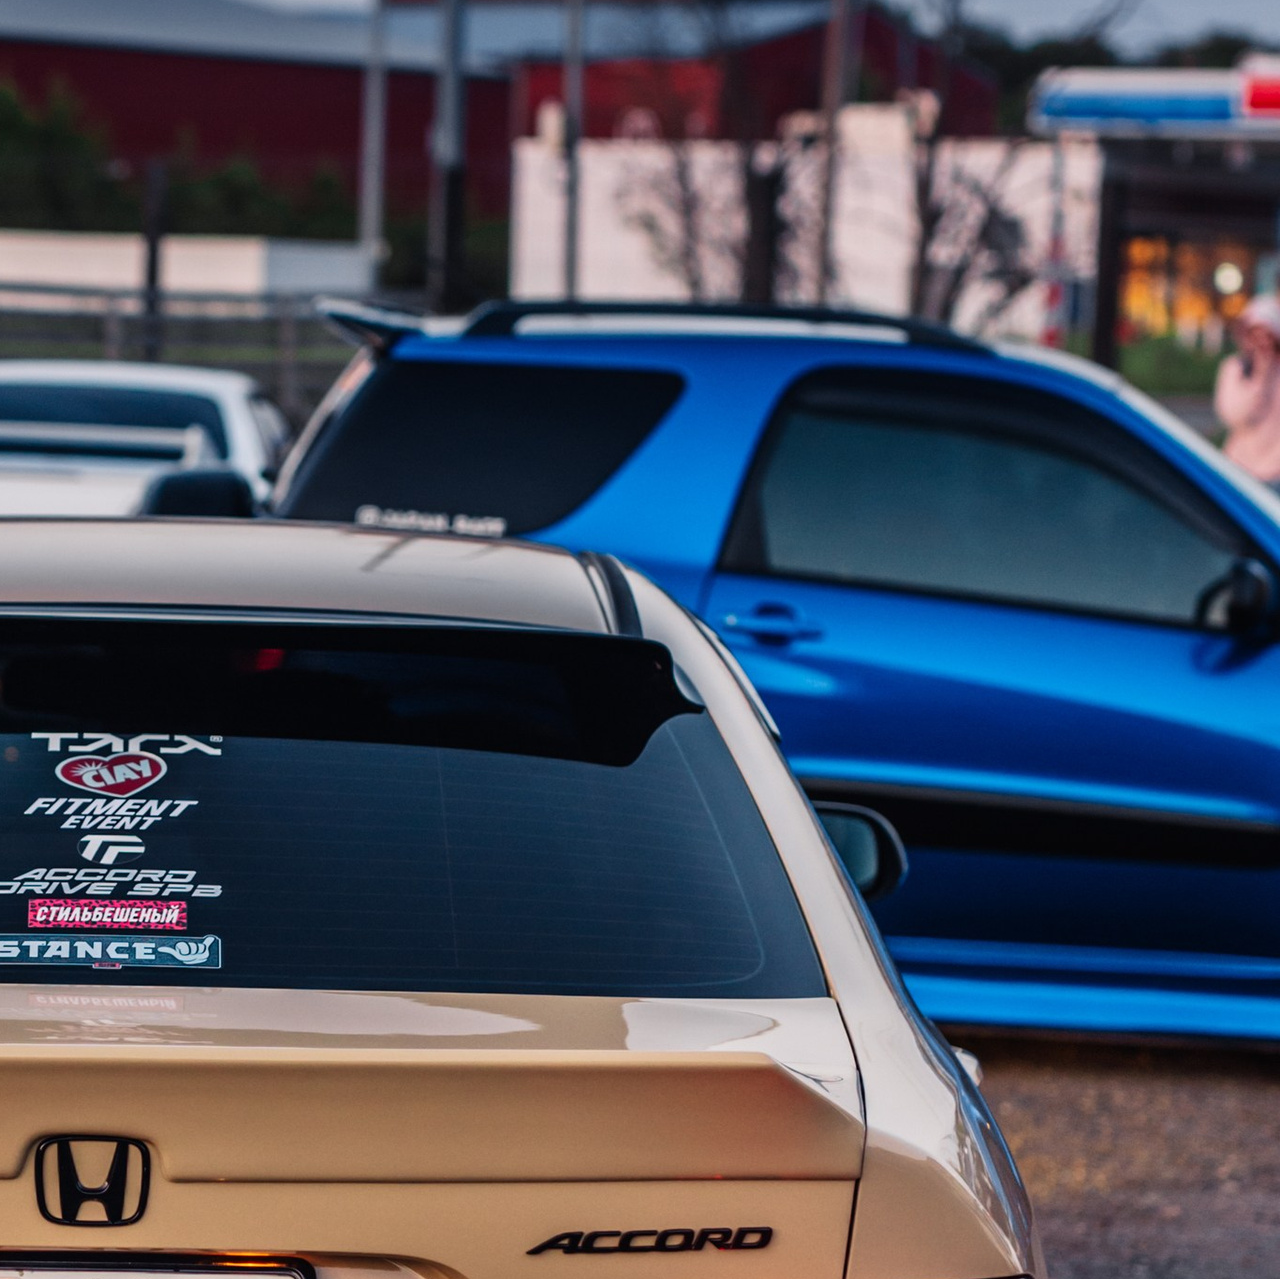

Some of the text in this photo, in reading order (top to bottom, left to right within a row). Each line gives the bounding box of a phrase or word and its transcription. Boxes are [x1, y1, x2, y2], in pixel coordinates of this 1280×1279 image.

[24, 797, 199, 817] FITMENT
[60, 815, 162, 830] EVENT
[13, 867, 197, 883] ACCORD
[126, 883, 222, 898] SPB
[35, 904, 180, 924] СТИЛЬБЕШЕНЫЙ
[525, 1226, 774, 1256] ACCORD
